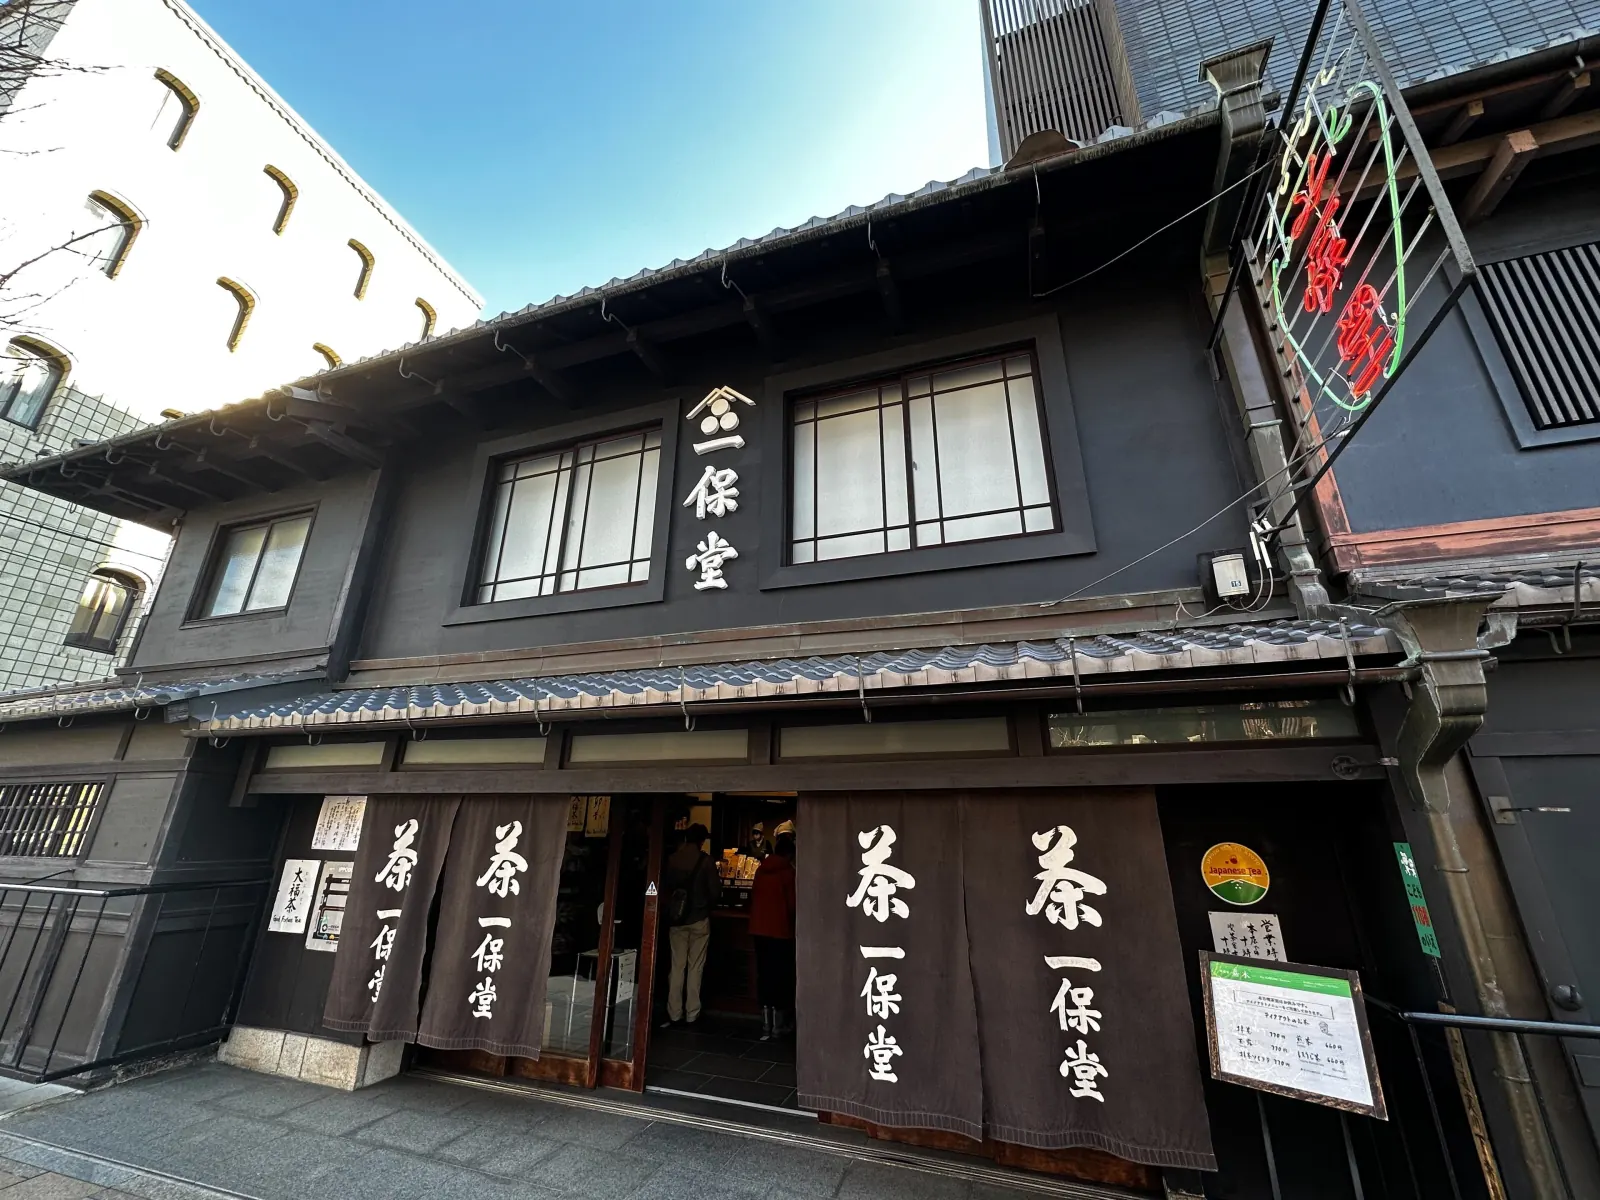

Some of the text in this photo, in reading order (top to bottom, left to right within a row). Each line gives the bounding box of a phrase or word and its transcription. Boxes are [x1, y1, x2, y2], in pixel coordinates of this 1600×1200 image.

[683, 434, 746, 590] 一保堂
[284, 866, 303, 913] 大福茶
[1209, 866, 1262, 876] Japanese Tea
